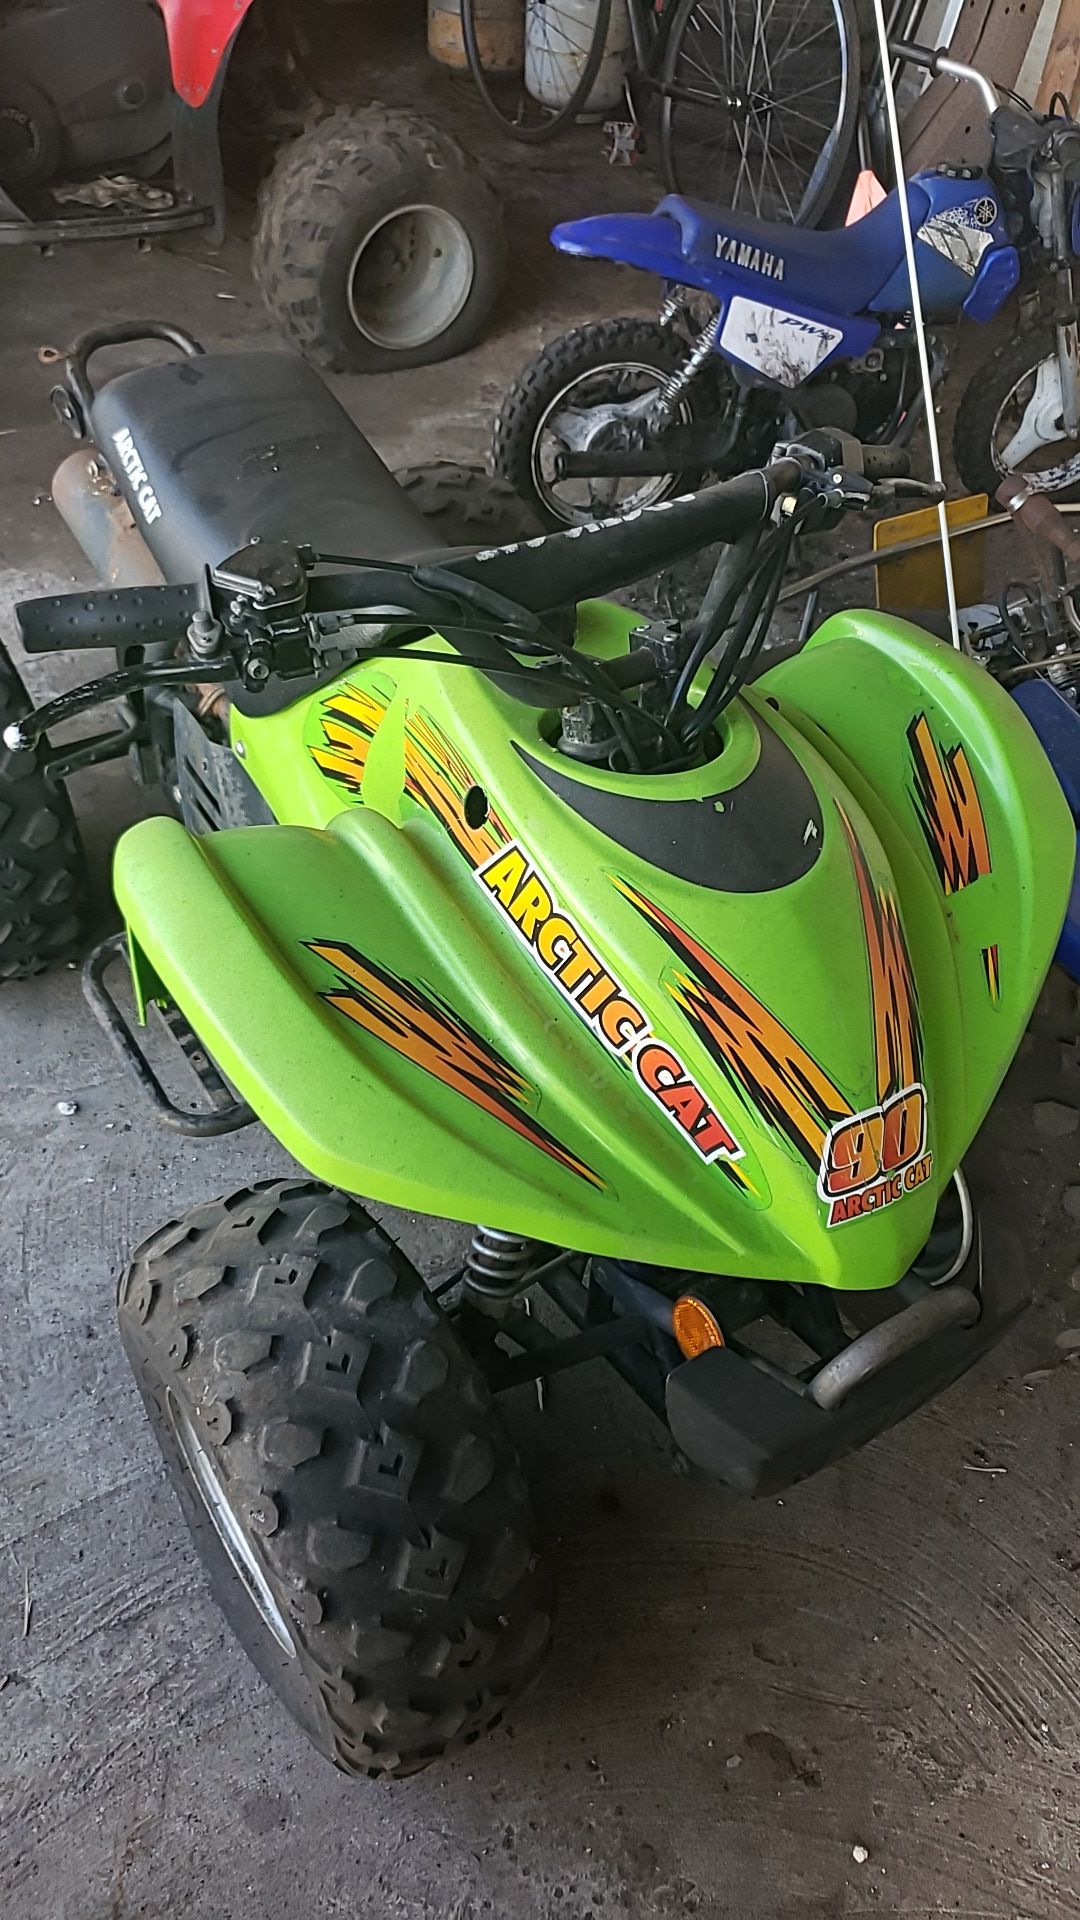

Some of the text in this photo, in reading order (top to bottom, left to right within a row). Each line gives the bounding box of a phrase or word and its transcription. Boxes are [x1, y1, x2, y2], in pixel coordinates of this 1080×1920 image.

[715, 233, 785, 281] YAMAHA
[111, 428, 163, 525] ARCTIC CAT
[478, 845, 742, 1160] ARCTIC CAT
[820, 1086, 926, 1200] 90
[829, 1154, 933, 1226] ARCTIC CAT
